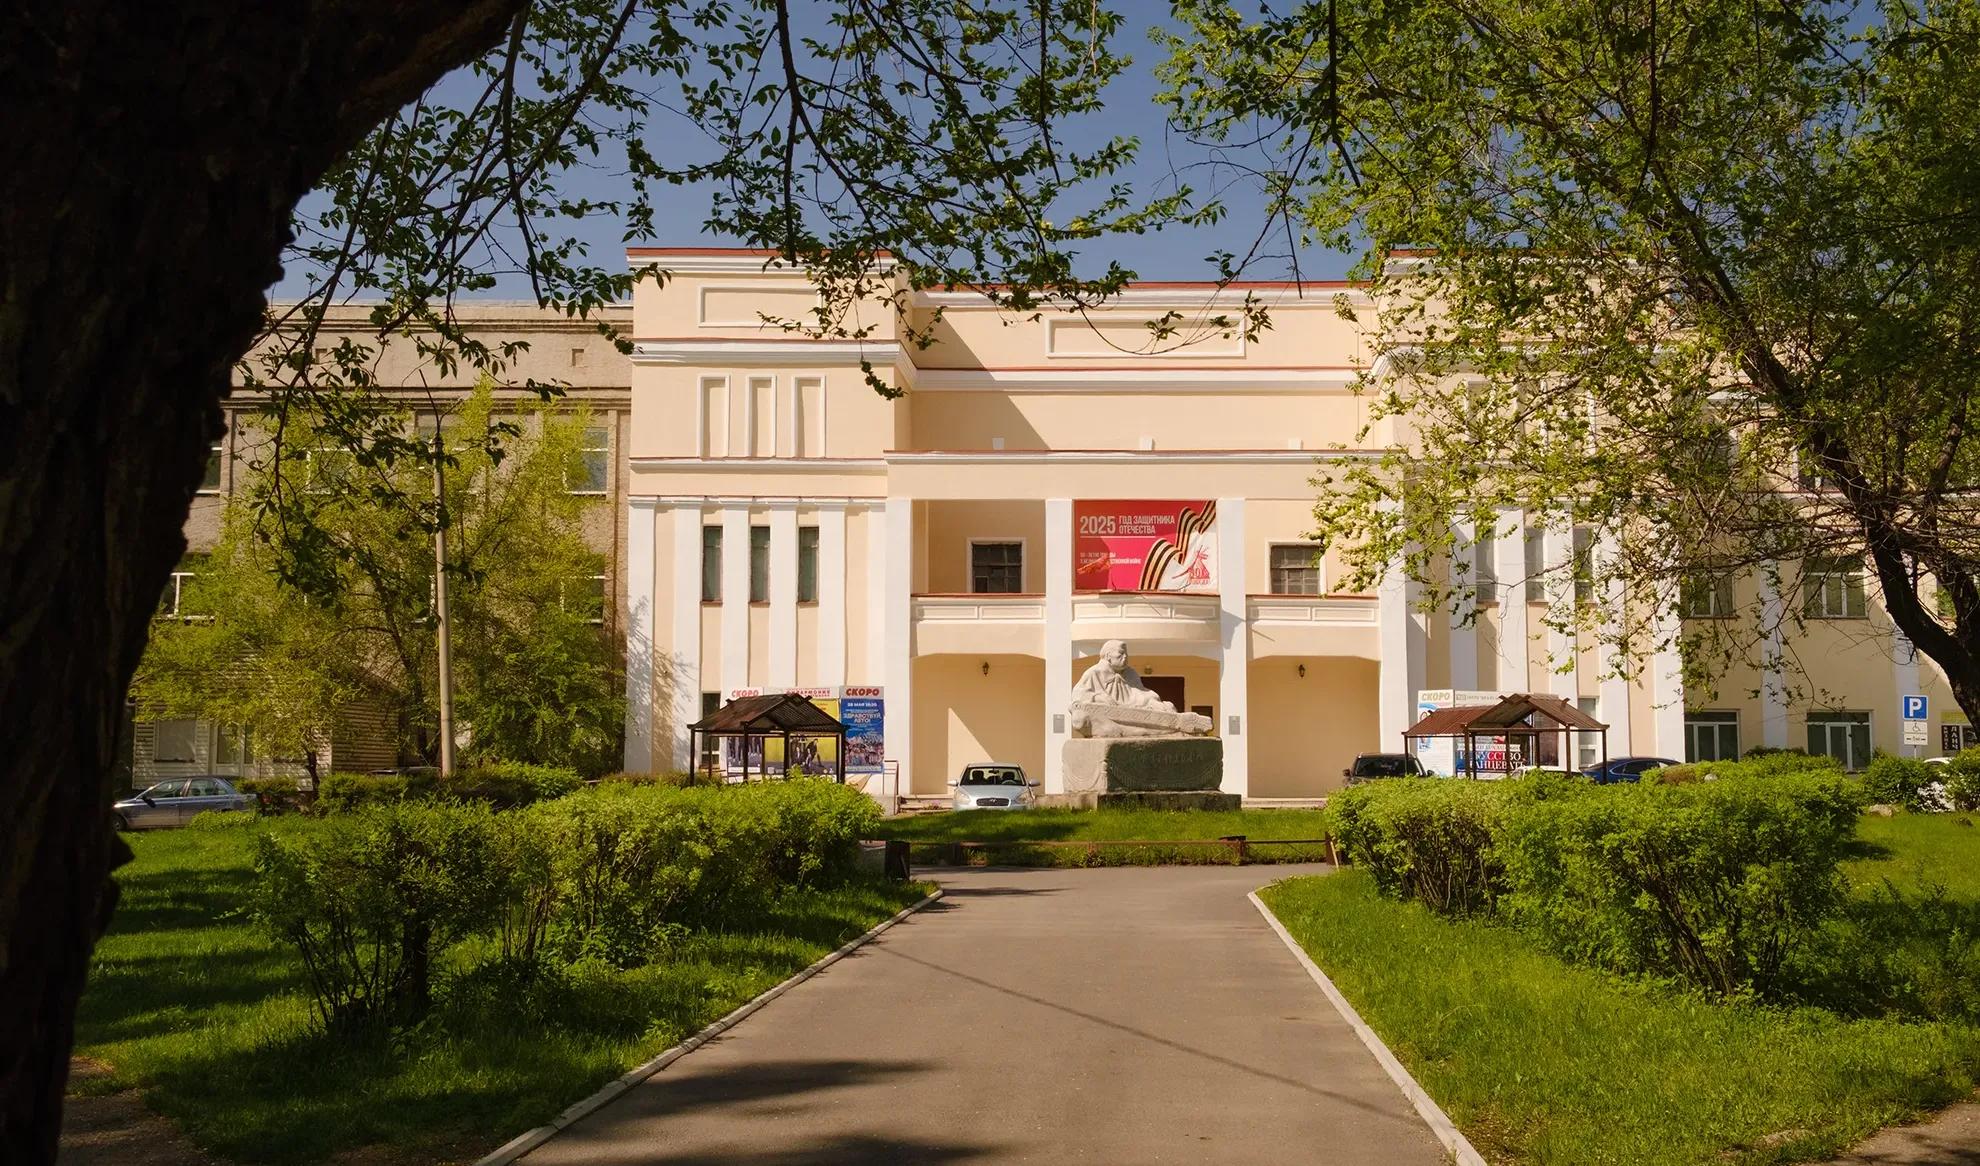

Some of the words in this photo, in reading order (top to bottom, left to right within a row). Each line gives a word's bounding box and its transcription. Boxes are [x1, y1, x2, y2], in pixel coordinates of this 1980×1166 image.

[1080, 515, 1115, 534] 2025
[1119, 515, 1133, 525] ГОД
[1134, 515, 1175, 525] ЗАЩИТНИКА
[1119, 525, 1156, 534] ОТЕЧЕСТВА
[731, 689, 759, 698] СКОРО
[846, 688, 880, 697] СКОРО
[1421, 692, 1450, 701] СКОРО
[1909, 698, 1922, 717] P
